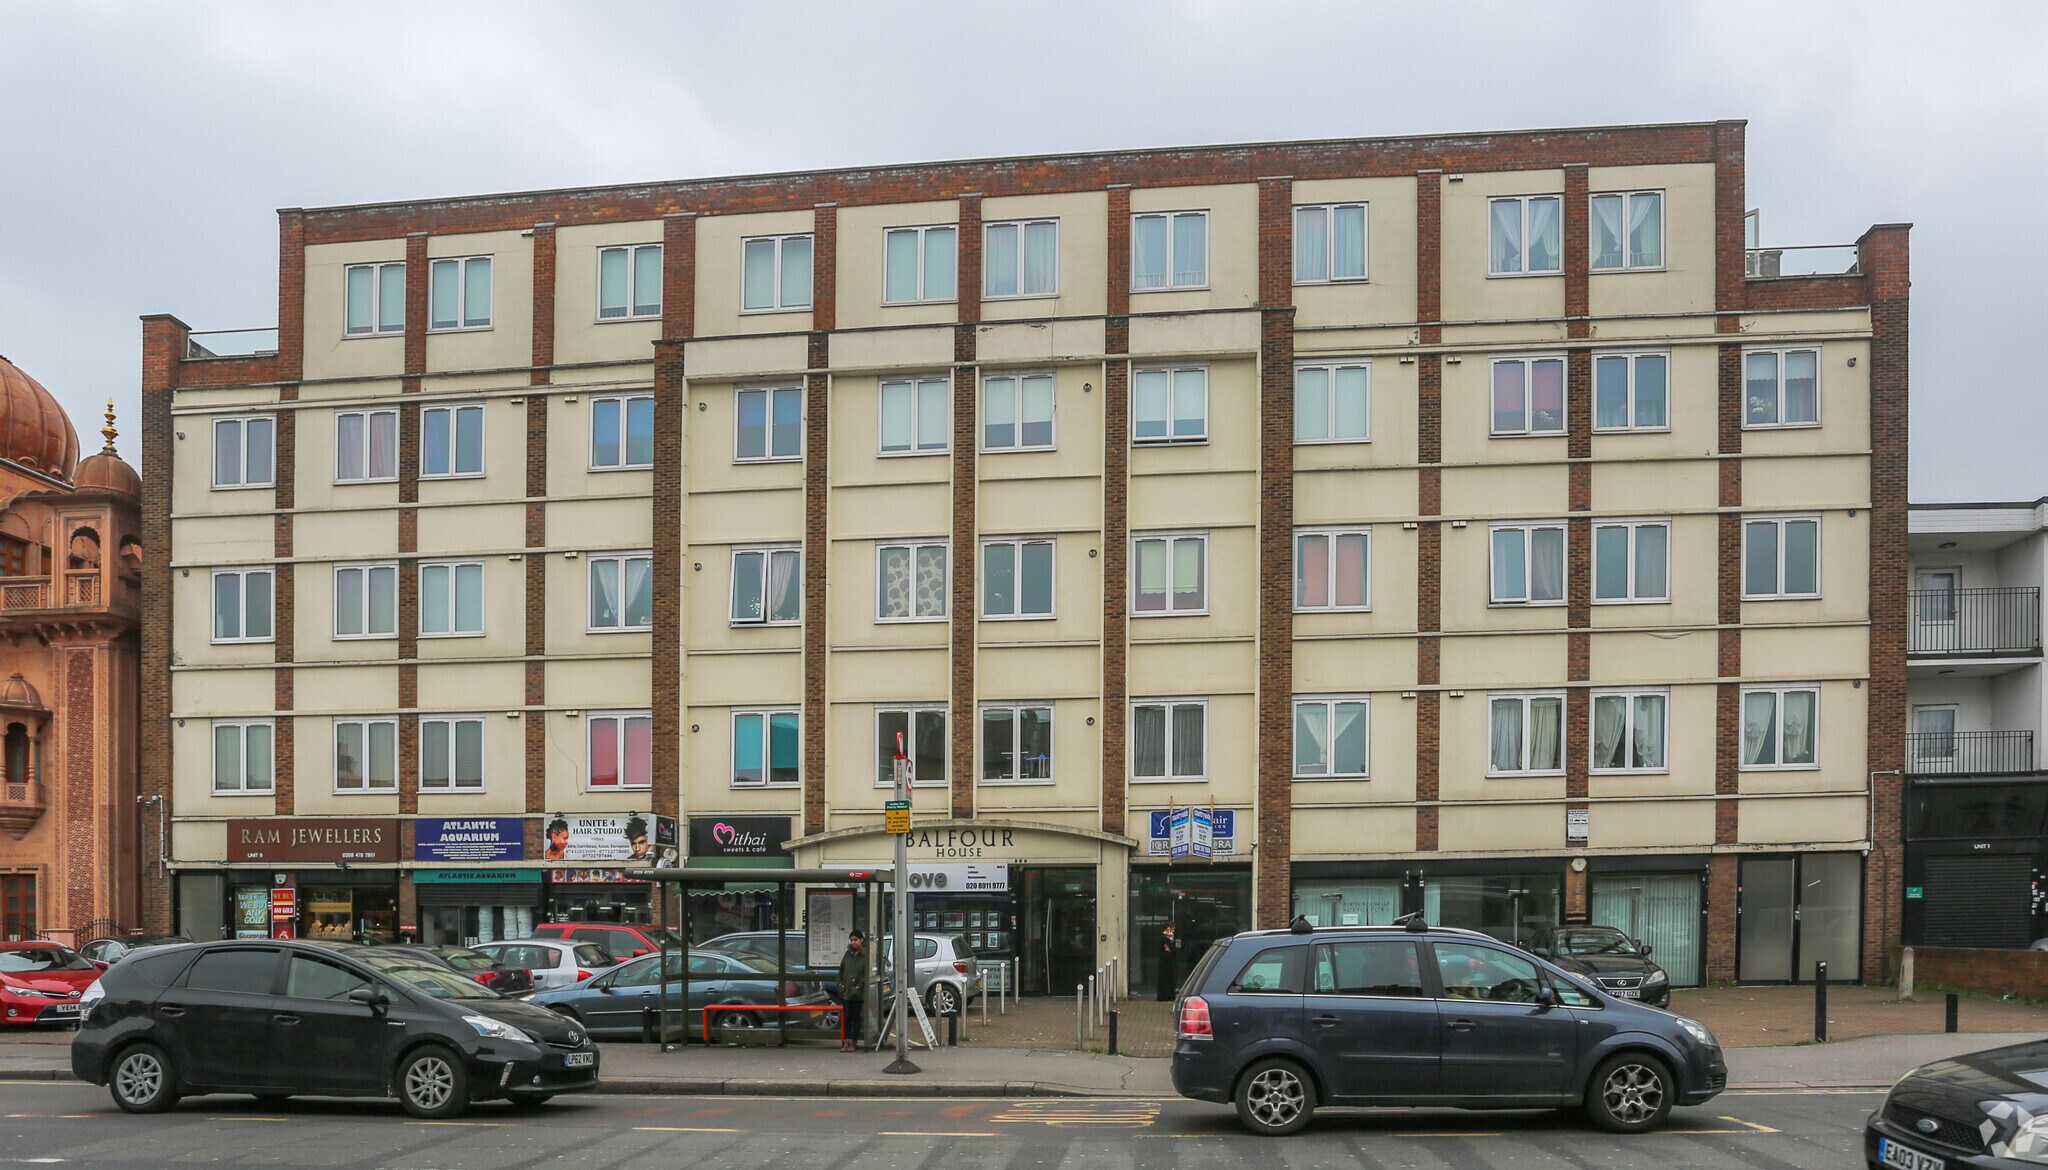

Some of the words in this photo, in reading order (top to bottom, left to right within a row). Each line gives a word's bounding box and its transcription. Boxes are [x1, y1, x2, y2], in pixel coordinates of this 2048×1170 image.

[442, 821, 496, 830] ATLANTIC
[242, 829, 280, 843] RAM
[291, 828, 382, 847] JEWELLERS
[440, 833, 500, 842] AQUARIUM
[906, 829, 1014, 847] BALFOUR
[936, 848, 982, 857] HOUSE
[254, 900, 268, 909] BUY
[568, 1054, 581, 1064] LP62
[1886, 1143, 1914, 1169] EA03
